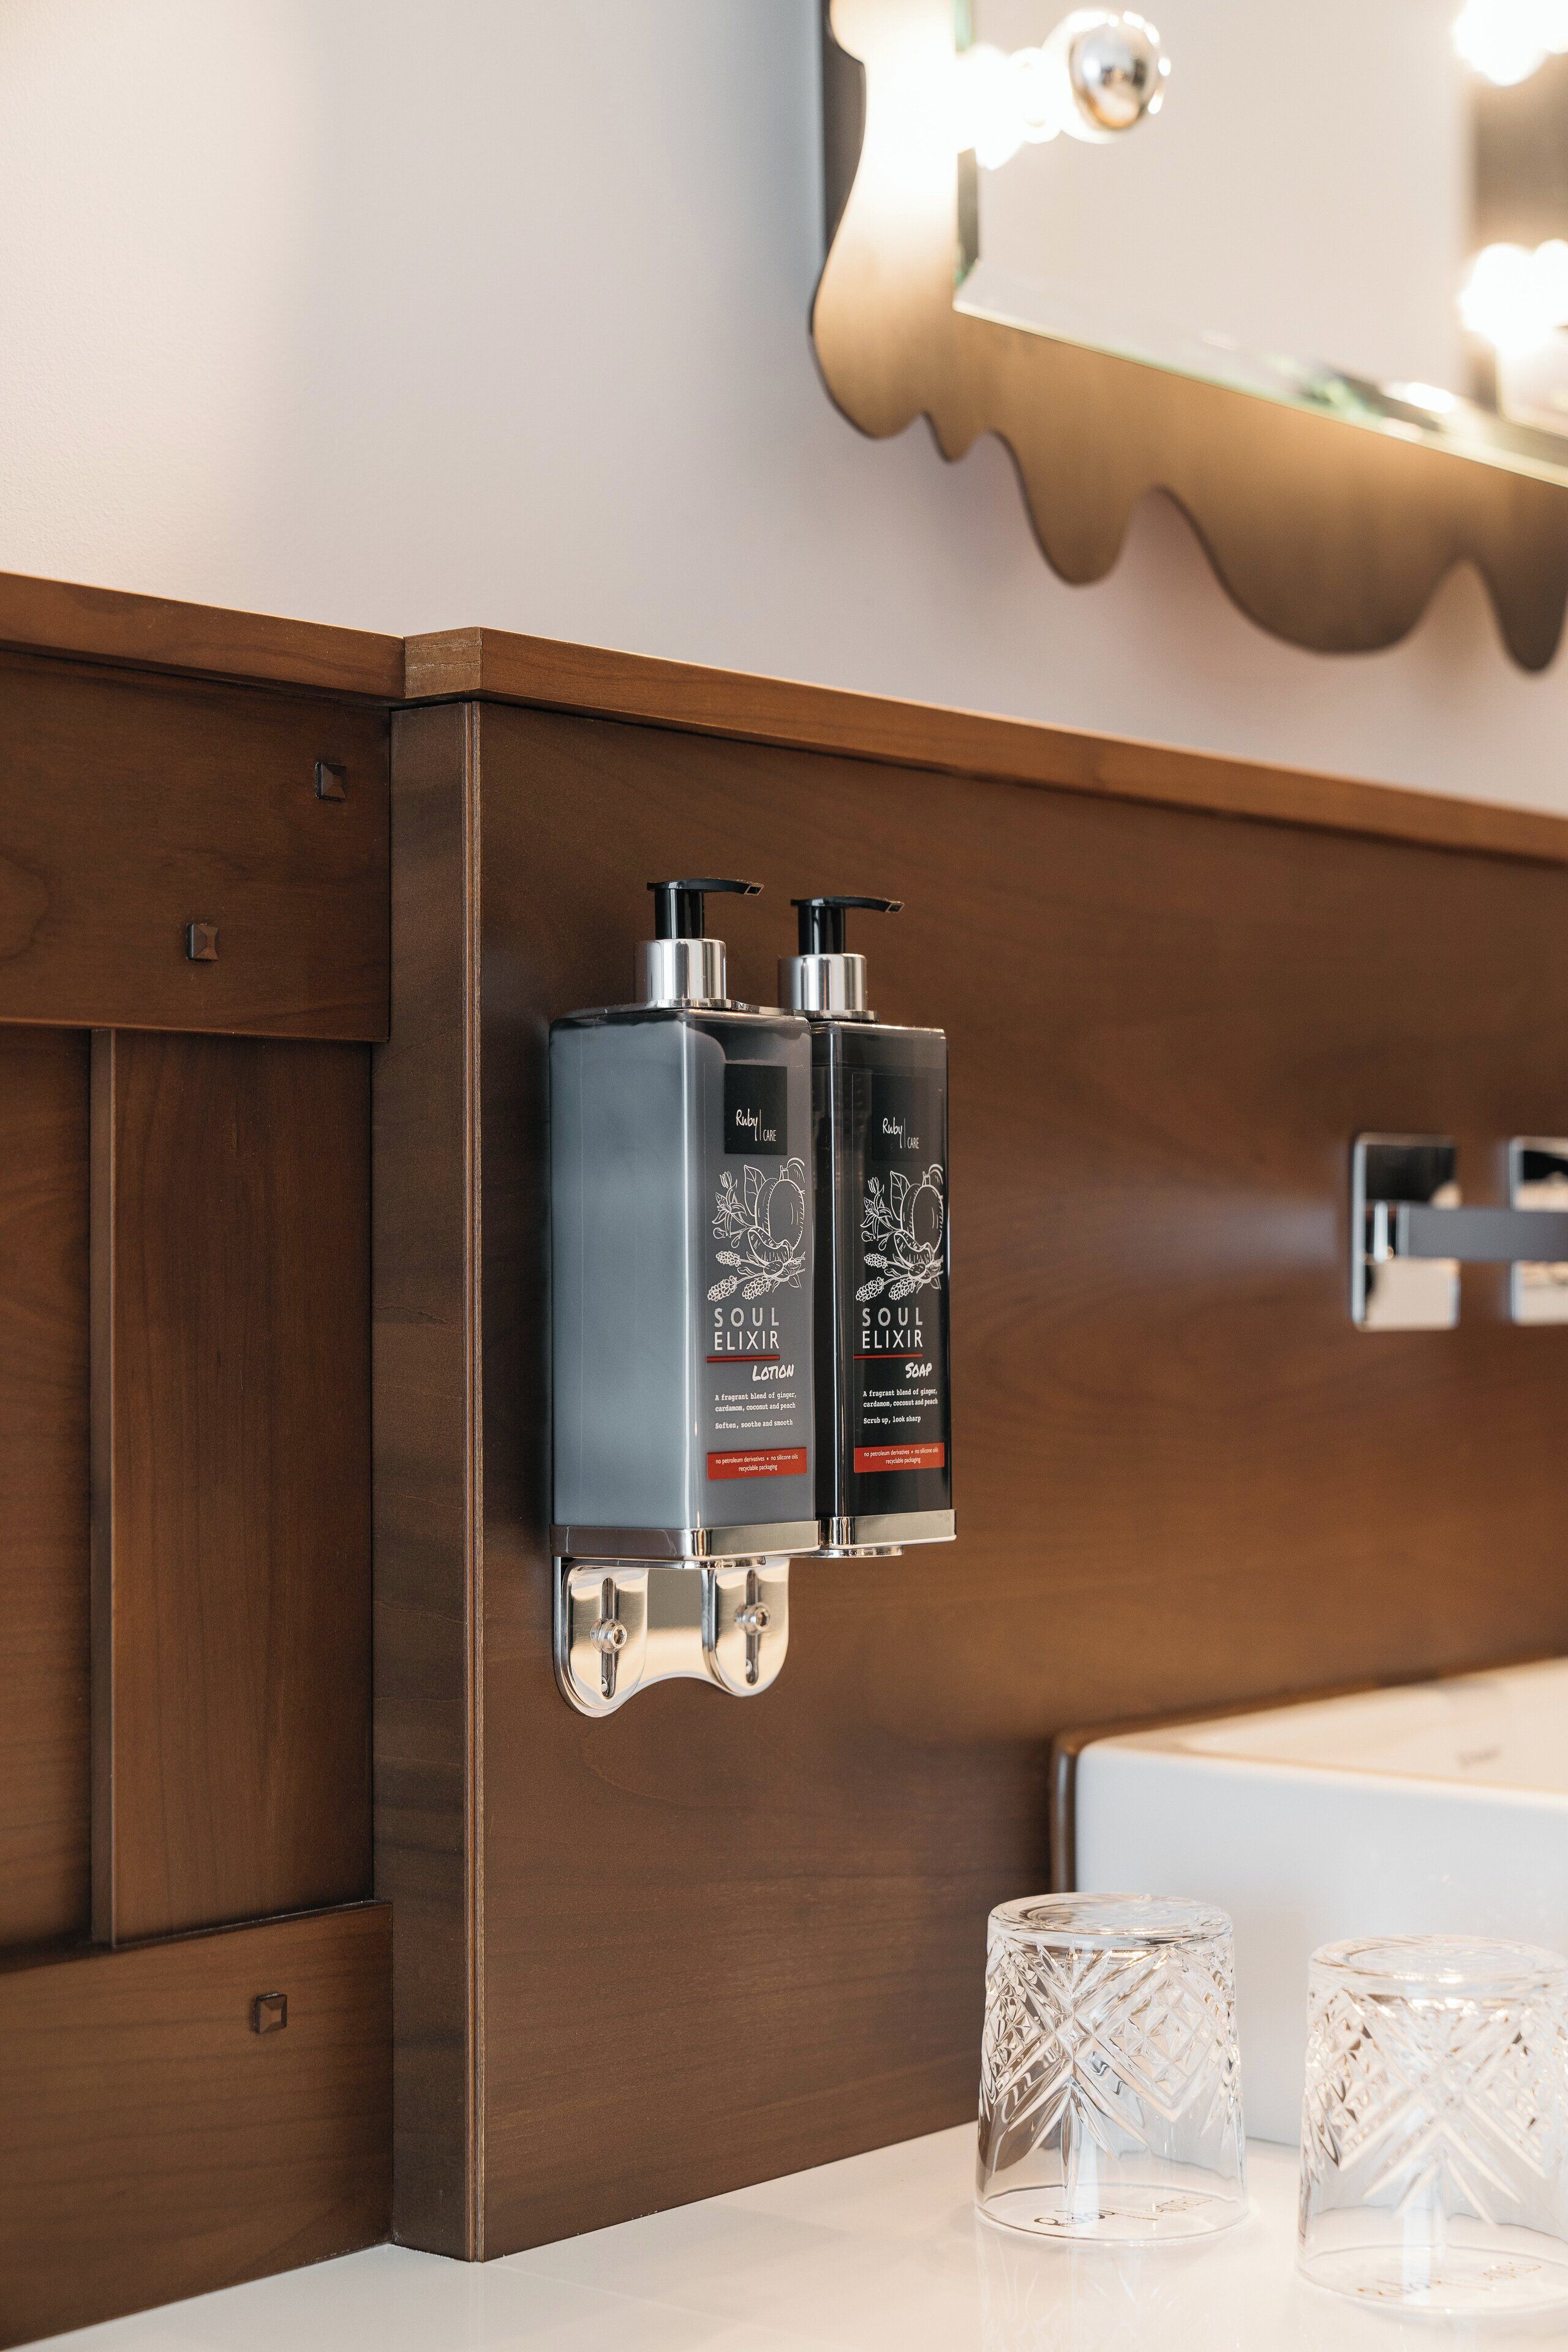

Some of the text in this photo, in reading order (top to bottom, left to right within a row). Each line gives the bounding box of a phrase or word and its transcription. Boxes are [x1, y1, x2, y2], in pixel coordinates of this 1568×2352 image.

[736, 1108, 758, 1141] Ruby
[883, 1117, 902, 1148] Ruby
[763, 1129, 777, 1141] CARE
[907, 1137, 919, 1148] CARE
[714, 1307, 779, 1327] SOUL
[862, 1307, 922, 1327] SOUL
[714, 1330, 780, 1351] ELIXIR
[862, 1329, 923, 1349] ELIXIR
[752, 1364, 794, 1381] LOTION
[905, 1362, 932, 1378] SOAP
